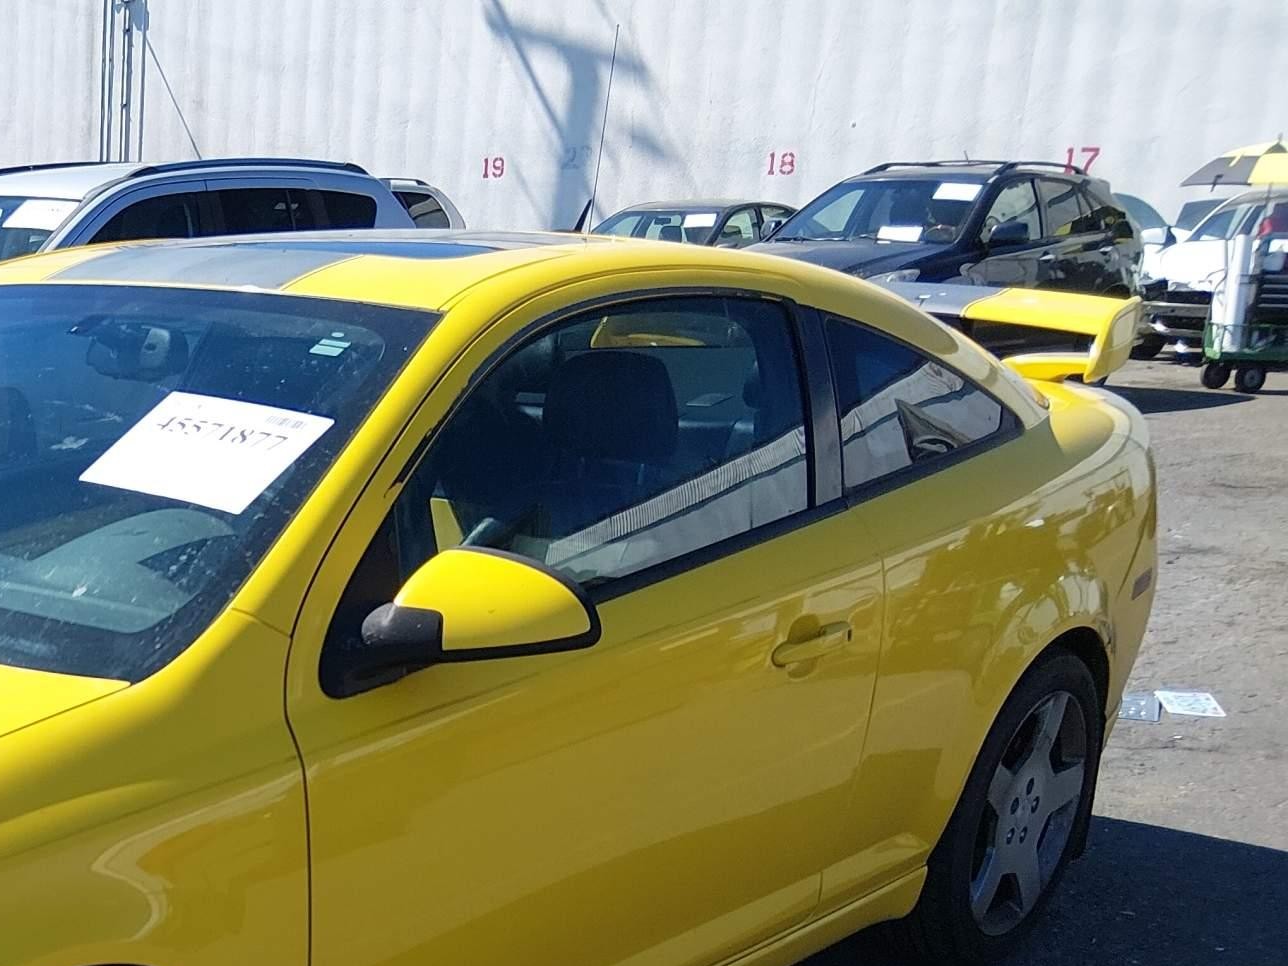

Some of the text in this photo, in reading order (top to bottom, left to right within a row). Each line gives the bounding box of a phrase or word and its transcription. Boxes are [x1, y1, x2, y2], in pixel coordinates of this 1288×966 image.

[482, 157, 505, 179] 19
[767, 151, 797, 176] 18
[1063, 147, 1101, 176] 17
